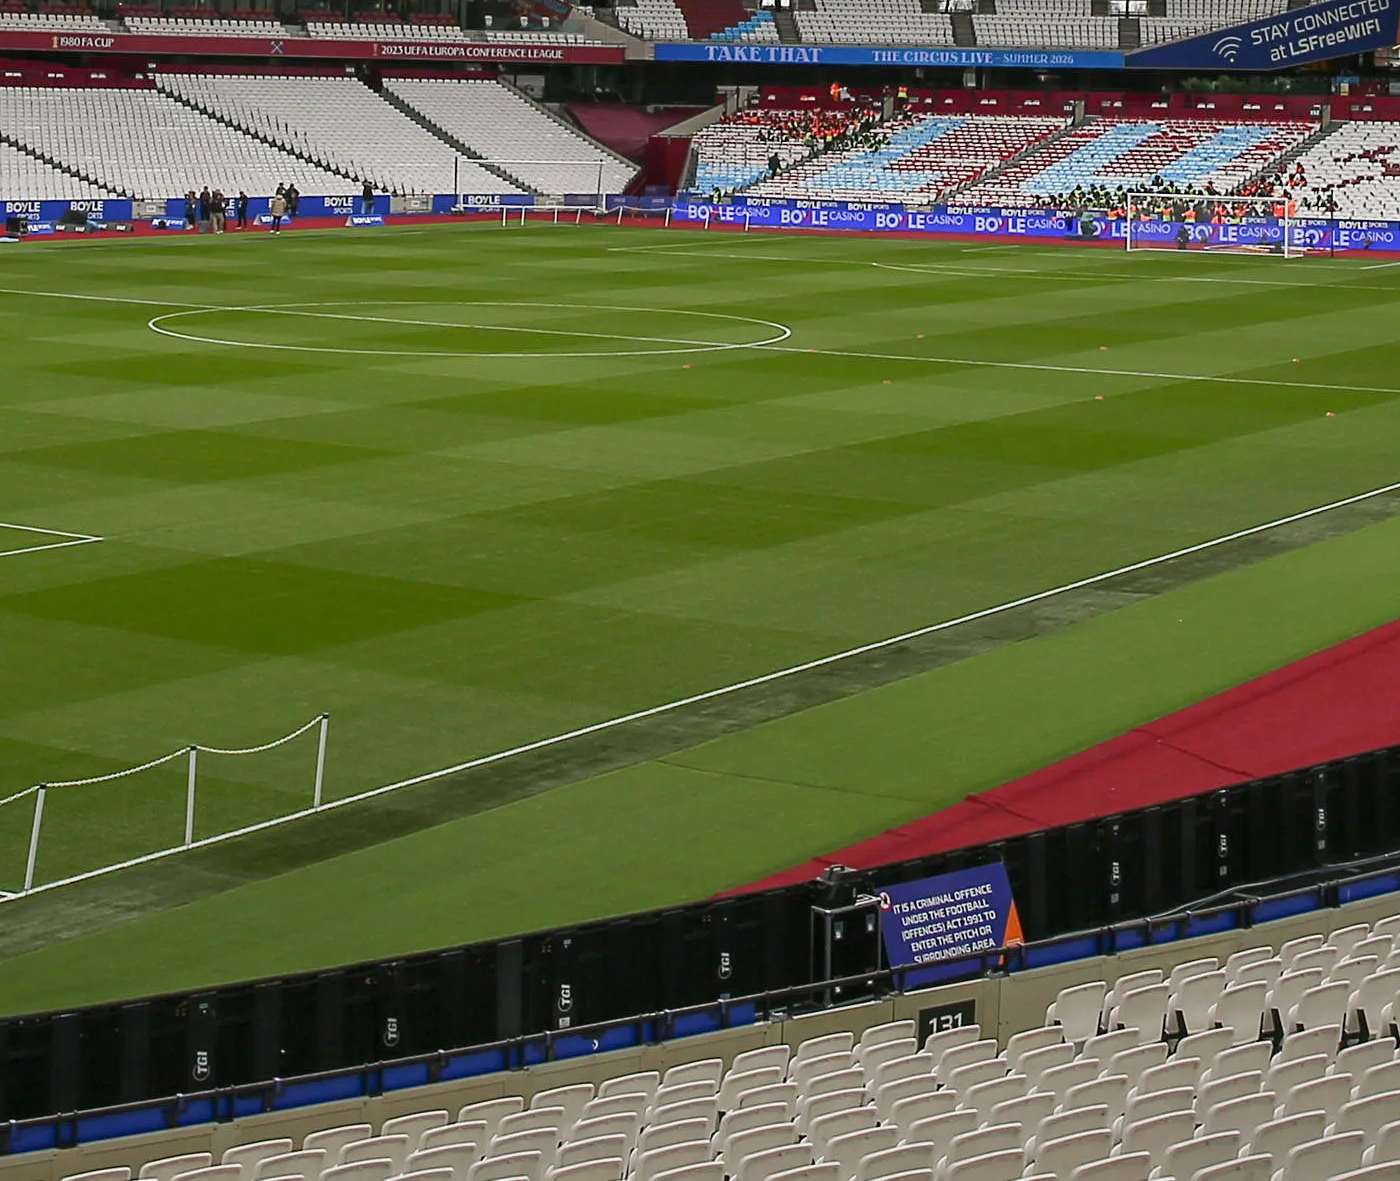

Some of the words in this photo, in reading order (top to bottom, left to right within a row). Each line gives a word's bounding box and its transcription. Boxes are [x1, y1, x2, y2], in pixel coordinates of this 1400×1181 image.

[1250, 21, 1291, 46] STAY
[60, 37, 80, 47] 1980
[82, 37, 94, 47] FA
[95, 37, 114, 47] CUP
[381, 45, 404, 55] 2023
[404, 46, 428, 55] UEFA
[428, 46, 465, 57] EUROPA
[466, 47, 527, 59] CONFERENCE
[528, 49, 564, 59] LEAGUE
[704, 45, 762, 62] TAKE
[766, 47, 822, 63] THAT
[872, 51, 900, 62] THE
[903, 51, 958, 63] CIRCUS
[962, 52, 993, 64] LIVE
[1003, 54, 1048, 64] SUMMER
[1050, 55, 1074, 64] 2026
[1270, 47, 1287, 61] at
[6, 201, 40, 213] BOYLE
[70, 200, 104, 211] BOYLE
[324, 197, 353, 207] BOYLE
[468, 195, 500, 205] BOYLE
[747, 198, 770, 207] BOYLE
[796, 201, 821, 209] BOYLE
[848, 203, 872, 211] BOYLE
[688, 205, 735, 221] BOYLE
[735, 207, 770, 218] CASINO
[781, 210, 828, 225] BOYLE
[829, 211, 864, 222] CASINO
[947, 207, 973, 215] BOYLE
[1001, 209, 1027, 217] BOYLE
[876, 213, 925, 229] BOYLE
[926, 215, 964, 225] CASINO
[975, 217, 1026, 233] BOYLE
[1027, 219, 1066, 229] CASINO
[1278, 219, 1306, 227] BOYLE
[1339, 221, 1368, 230] BOYLE
[1184, 224, 1238, 241] BOYLE
[1240, 227, 1280, 237] CASINO
[1294, 229, 1350, 246] BOYLE
[1351, 231, 1394, 242] CASINO
[1112, 862, 1120, 882] TGI
[892, 904, 900, 914] IT
[900, 902, 910, 913] IS
[910, 901, 916, 911] A
[916, 893, 955, 909] CRIMINAL
[956, 883, 992, 901] OFFENCE
[902, 912, 928, 926] UNDER
[929, 908, 946, 921] THE
[946, 899, 989, 917] FOOTBALL
[902, 923, 946, 942] (OFFENCES)
[947, 919, 962, 929] ACT
[964, 914, 983, 927] 1991
[984, 911, 996, 921] TO
[911, 938, 936, 951] ENTER
[936, 934, 954, 947] THE
[954, 929, 978, 943] PITCH
[979, 925, 992, 935] OR
[914, 943, 972, 963] SURROUNDING
[972, 937, 996, 951] AREA
[721, 953, 730, 975] TGI
[561, 985, 570, 1006] TGI
[388, 1019, 398, 1040] TGI
[929, 1013, 962, 1035] 131
[197, 1051, 208, 1075] TGI
